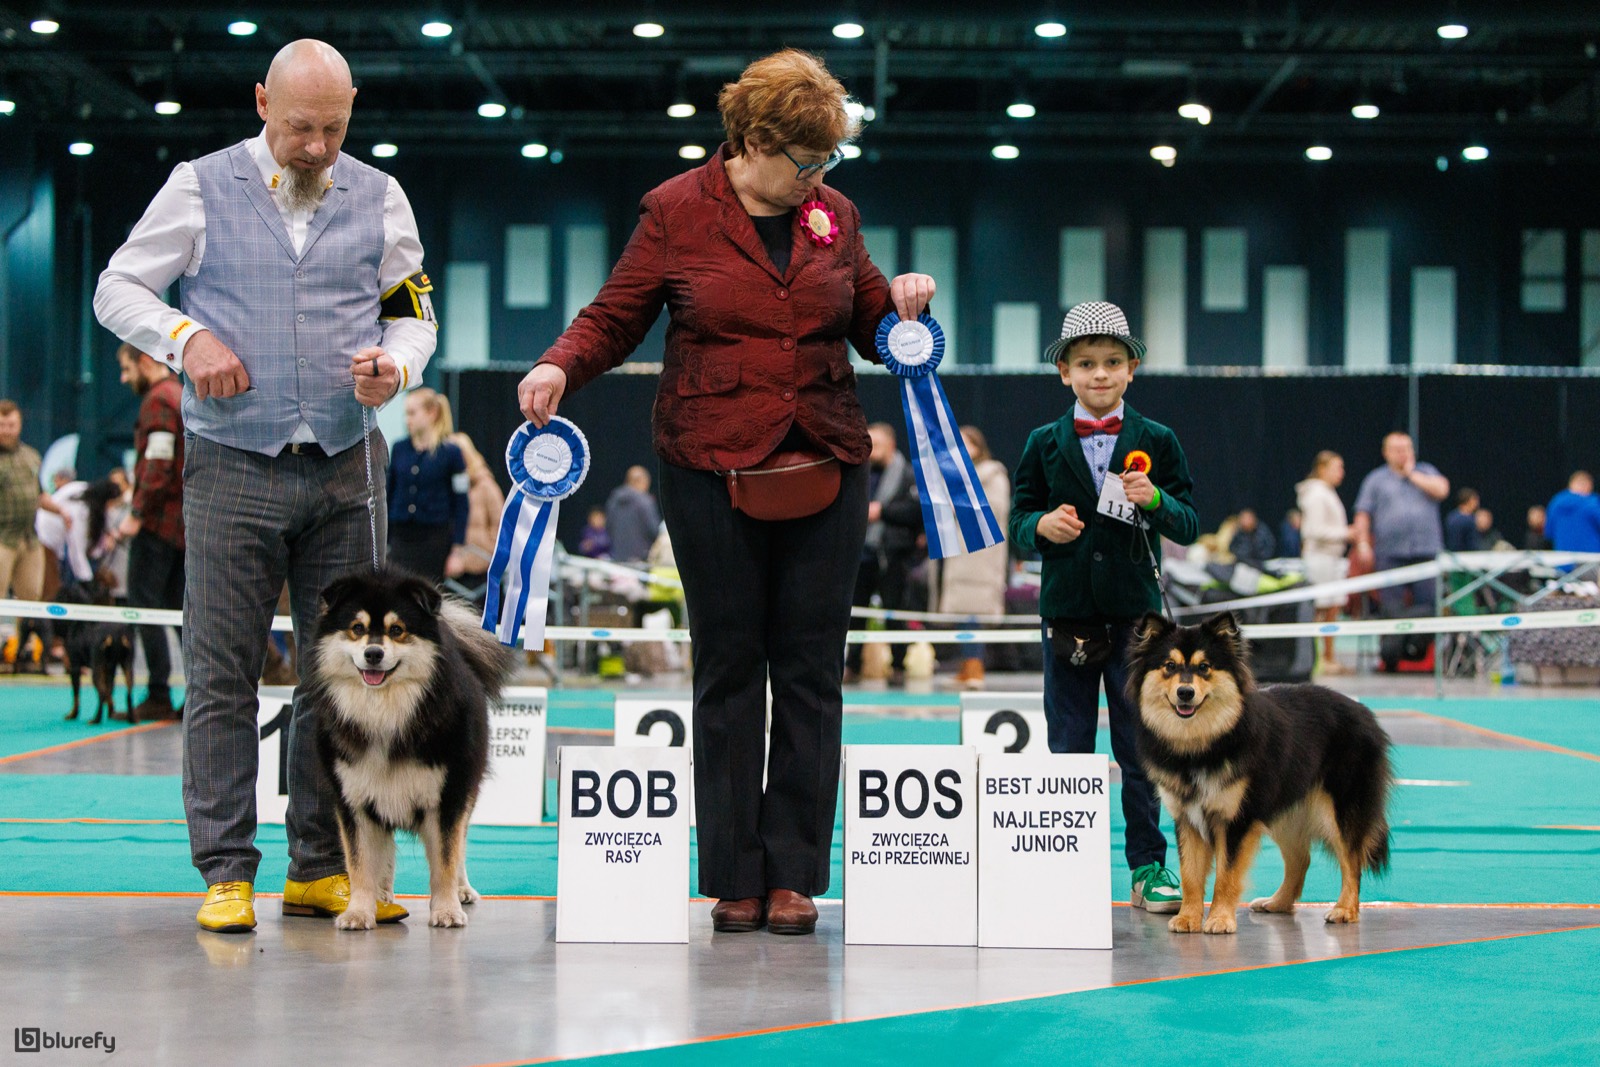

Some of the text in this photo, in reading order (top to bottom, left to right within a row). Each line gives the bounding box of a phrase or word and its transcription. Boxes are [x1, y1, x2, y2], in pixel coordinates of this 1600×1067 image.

[1106, 500, 1138, 523] 112
[571, 770, 677, 818] BOB
[859, 769, 962, 819] BOS
[987, 778, 1103, 794] BEST JUNIOR
[994, 811, 1096, 828] NAJLEPSZY
[585, 832, 662, 849] ZWYCIĘZCA
[872, 833, 949, 850] ZWYCIĘZCA
[1012, 835, 1078, 852] JUNIOR
[606, 850, 641, 863] RASY
[852, 851, 969, 864] PŁCI PRZECIWNEJ
